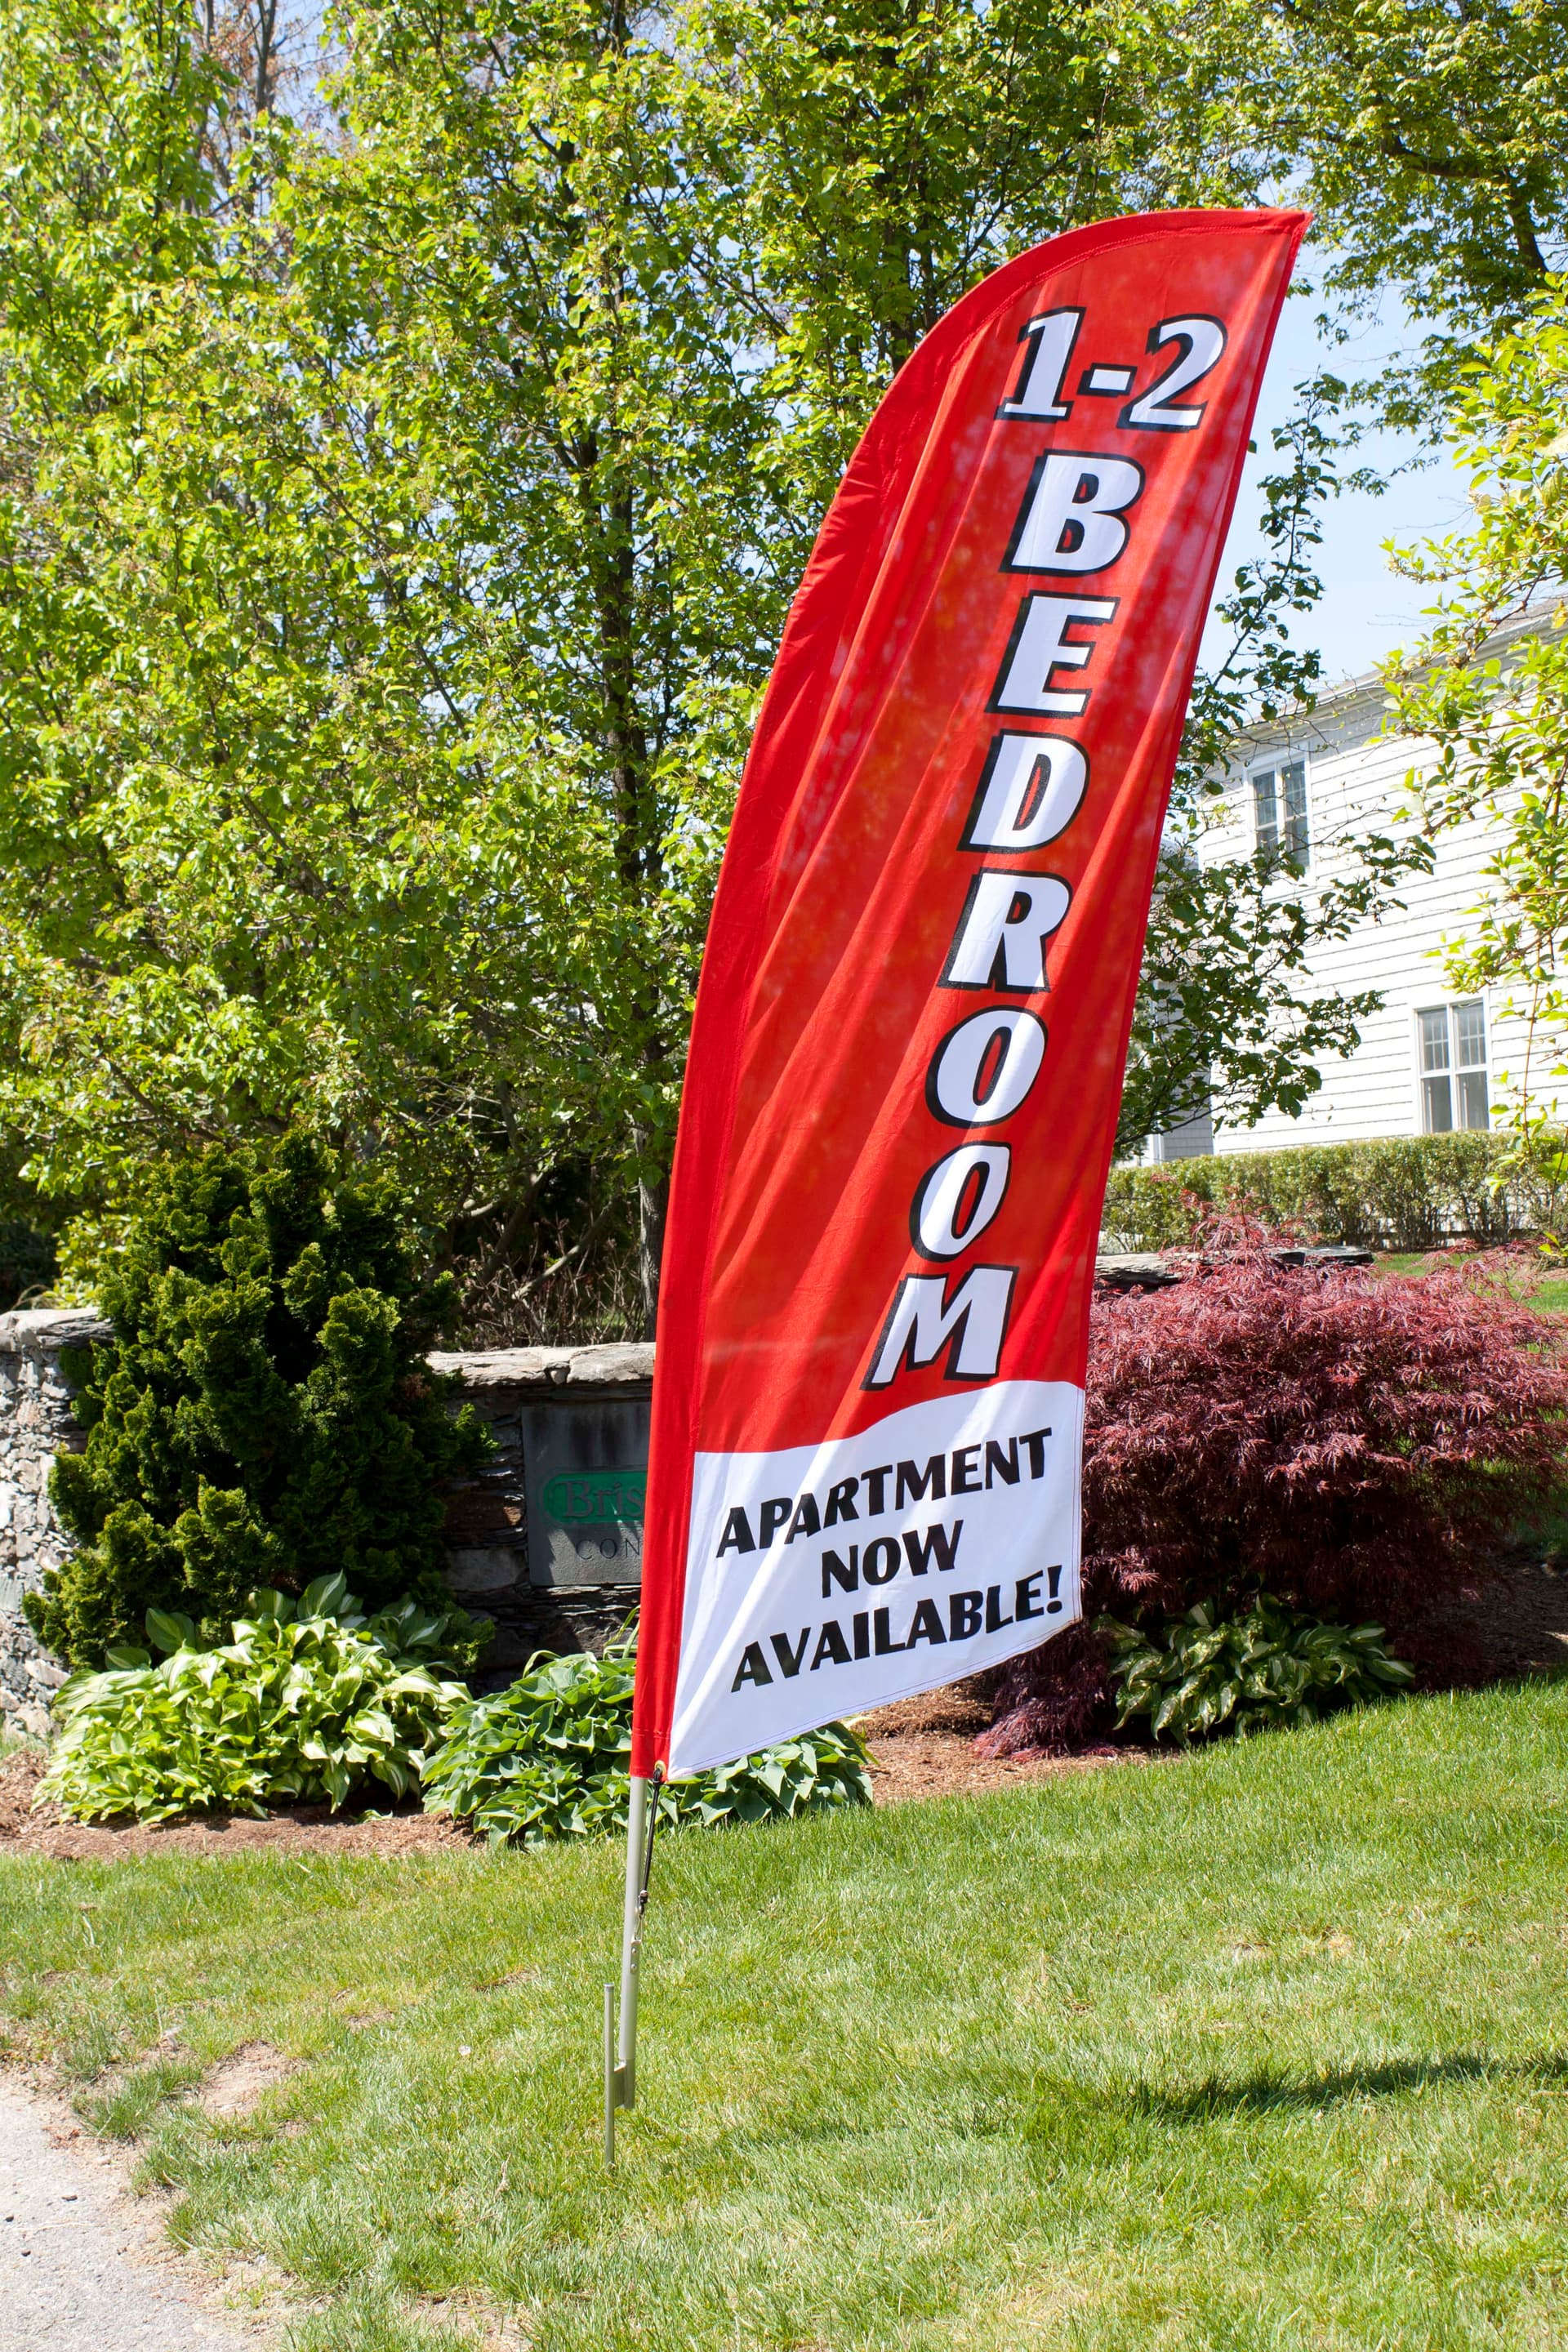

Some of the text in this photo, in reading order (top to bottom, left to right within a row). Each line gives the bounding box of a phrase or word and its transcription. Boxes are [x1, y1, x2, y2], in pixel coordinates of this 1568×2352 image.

[995, 306, 1227, 431] 1-2
[860, 448, 1145, 1390] BEDROOM
[716, 1428, 1052, 1558] APARTMENT
[822, 1520, 964, 1597] NOW
[731, 1565, 1062, 1693] AVAILABLE!
